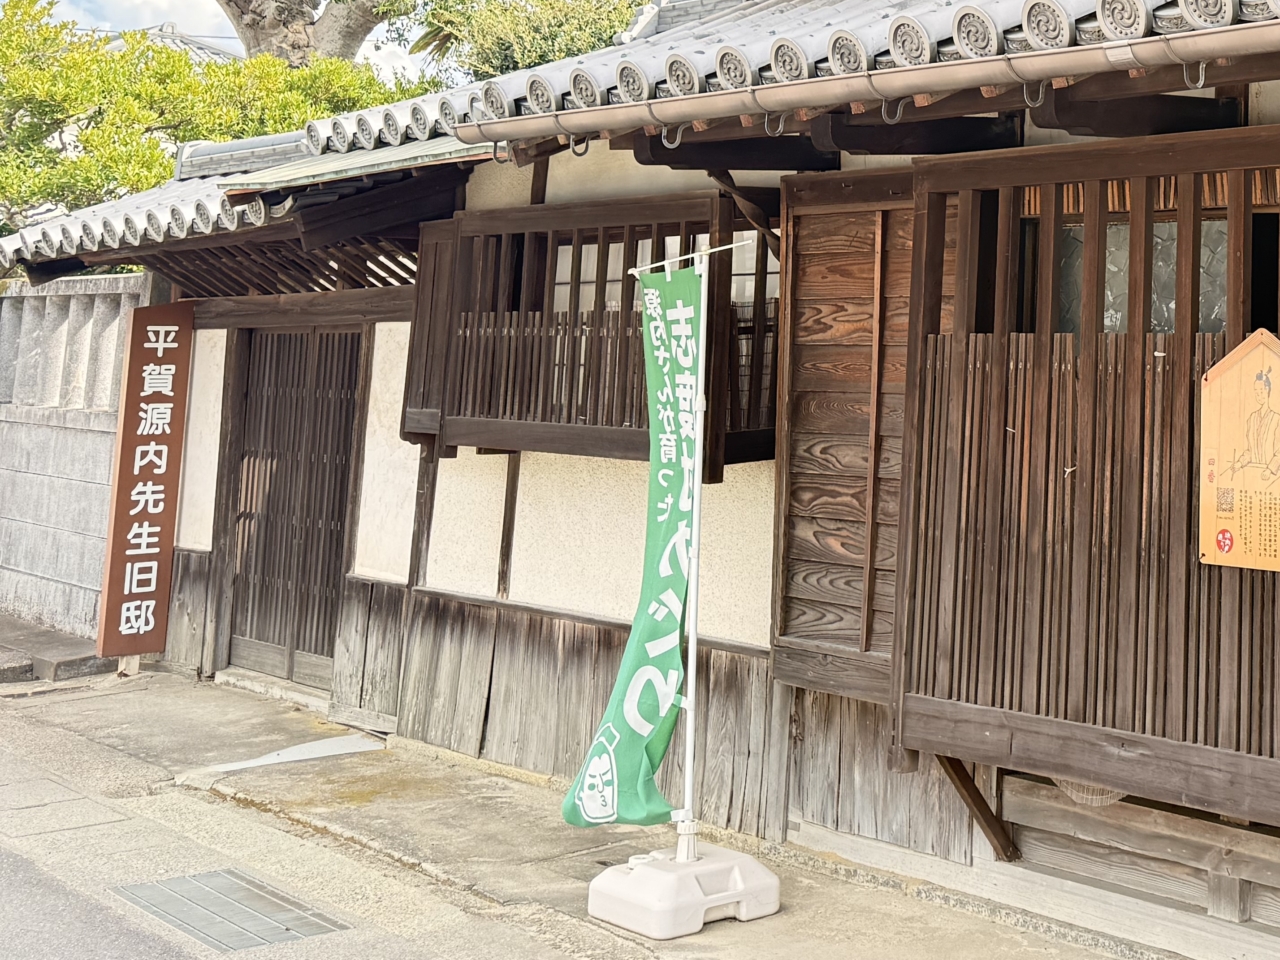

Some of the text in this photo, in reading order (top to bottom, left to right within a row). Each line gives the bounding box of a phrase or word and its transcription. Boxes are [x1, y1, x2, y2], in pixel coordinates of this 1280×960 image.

[118, 324, 179, 636] 平賀源内先生旧邸
